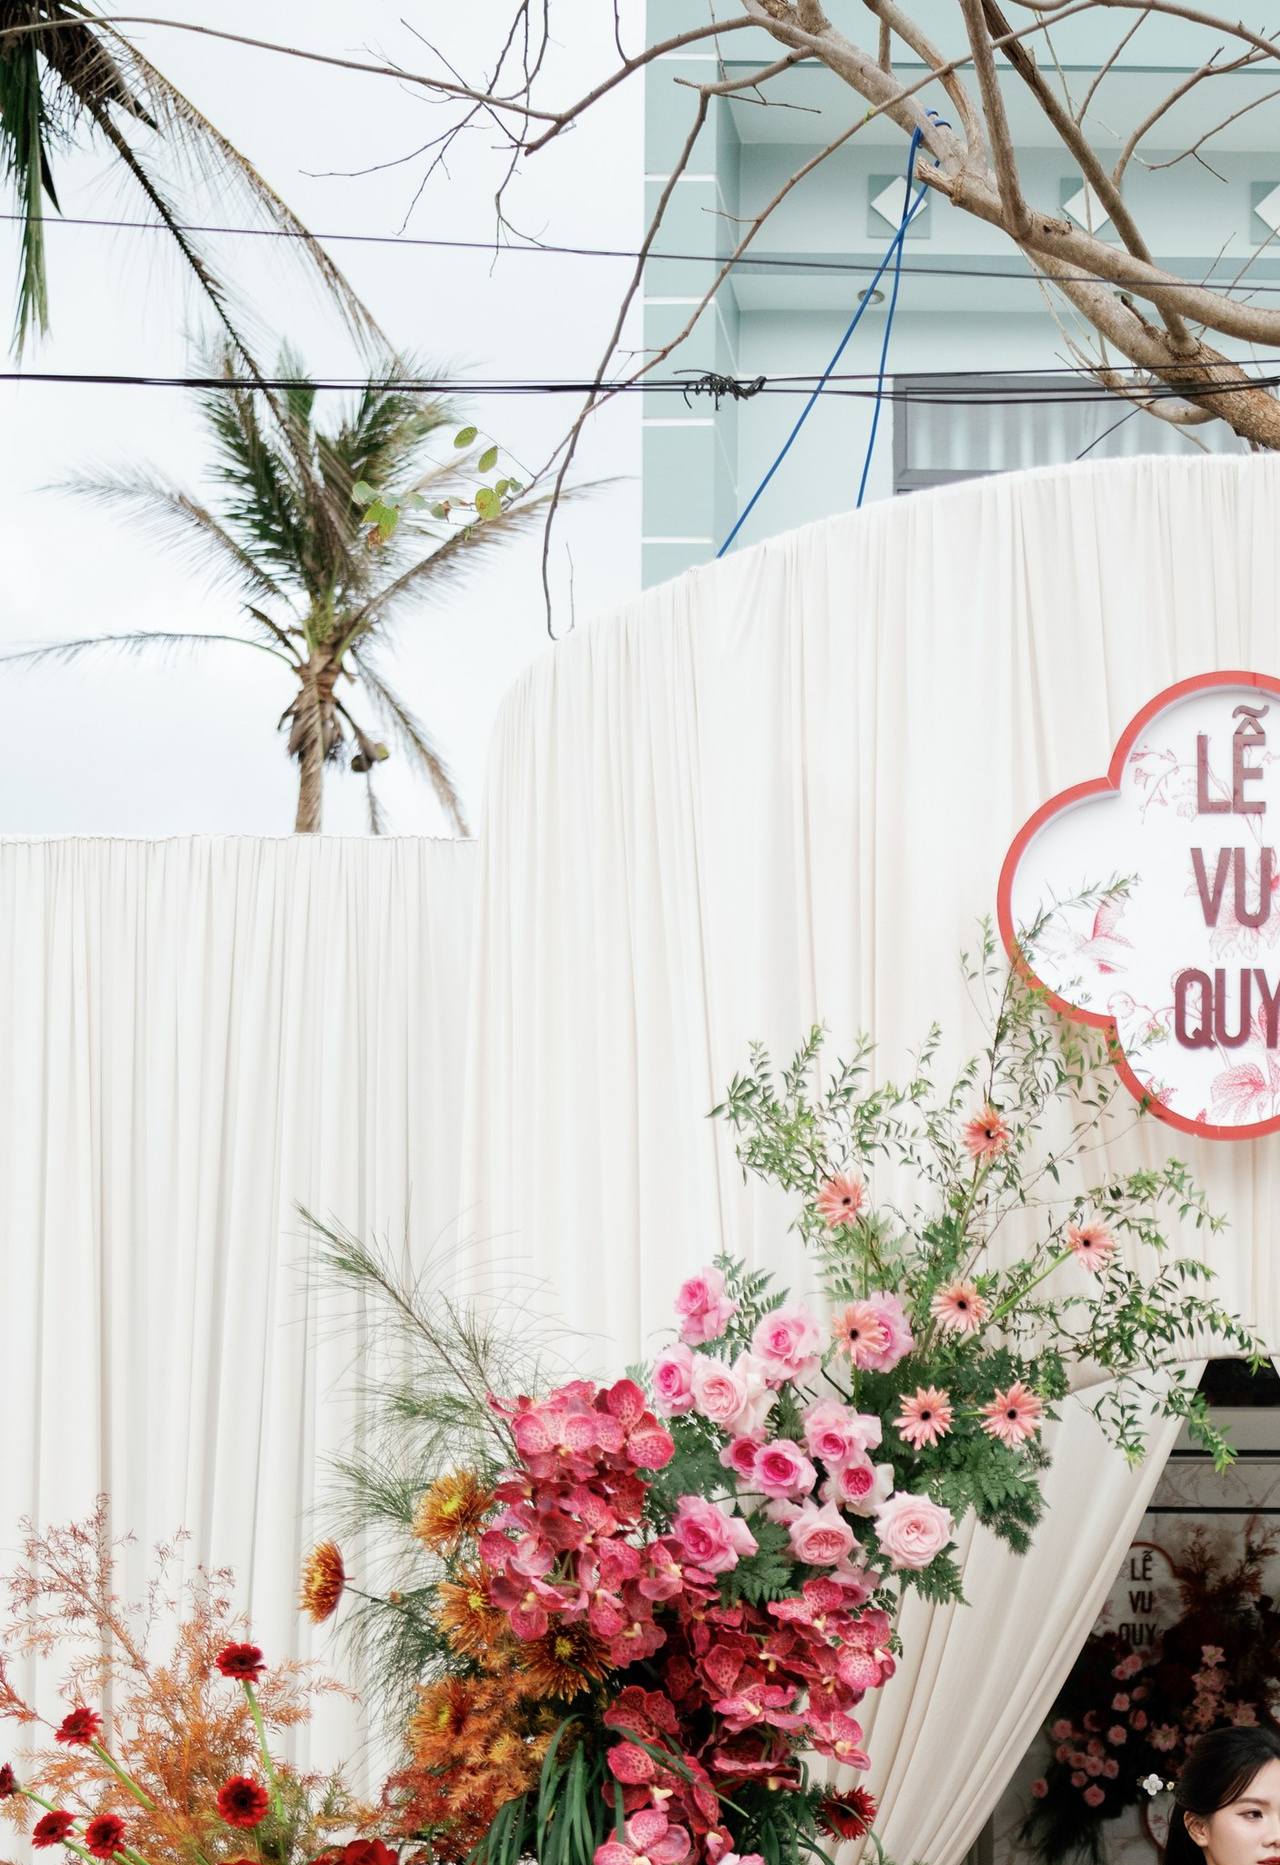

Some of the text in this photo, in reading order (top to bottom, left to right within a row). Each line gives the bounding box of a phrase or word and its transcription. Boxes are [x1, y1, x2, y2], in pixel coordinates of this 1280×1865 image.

[1196, 704, 1270, 815] LỄ
[1190, 846, 1273, 929] VU
[1129, 1591, 1152, 1614] VU
